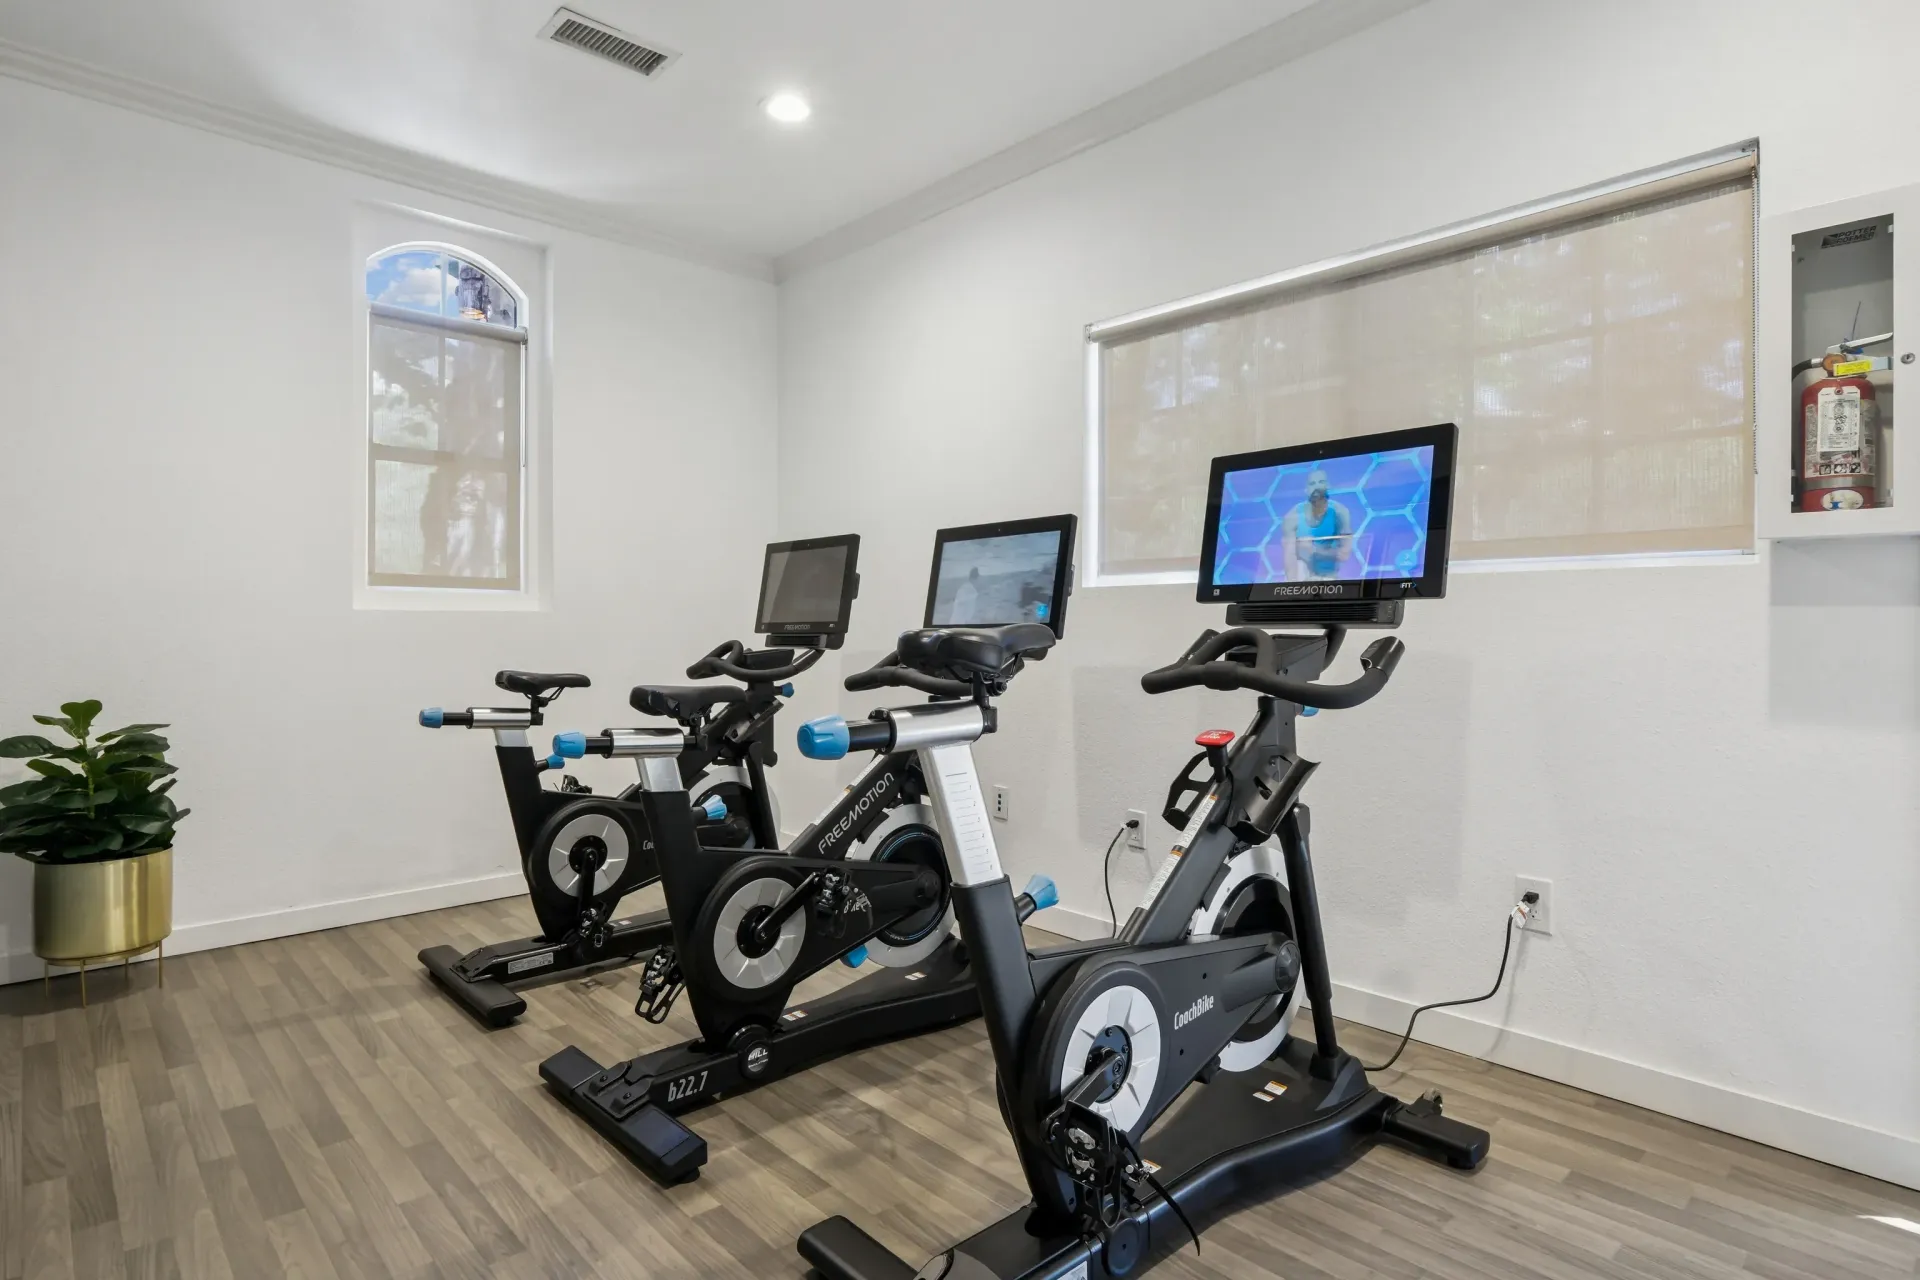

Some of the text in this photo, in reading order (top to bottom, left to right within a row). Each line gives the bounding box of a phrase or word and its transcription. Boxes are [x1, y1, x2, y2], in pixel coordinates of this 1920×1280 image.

[1274, 585, 1343, 596] FREEMOTION
[818, 772, 895, 854] FREEMOTION
[1174, 994, 1214, 1030] CoachBike
[667, 1070, 709, 1102] b22.7
